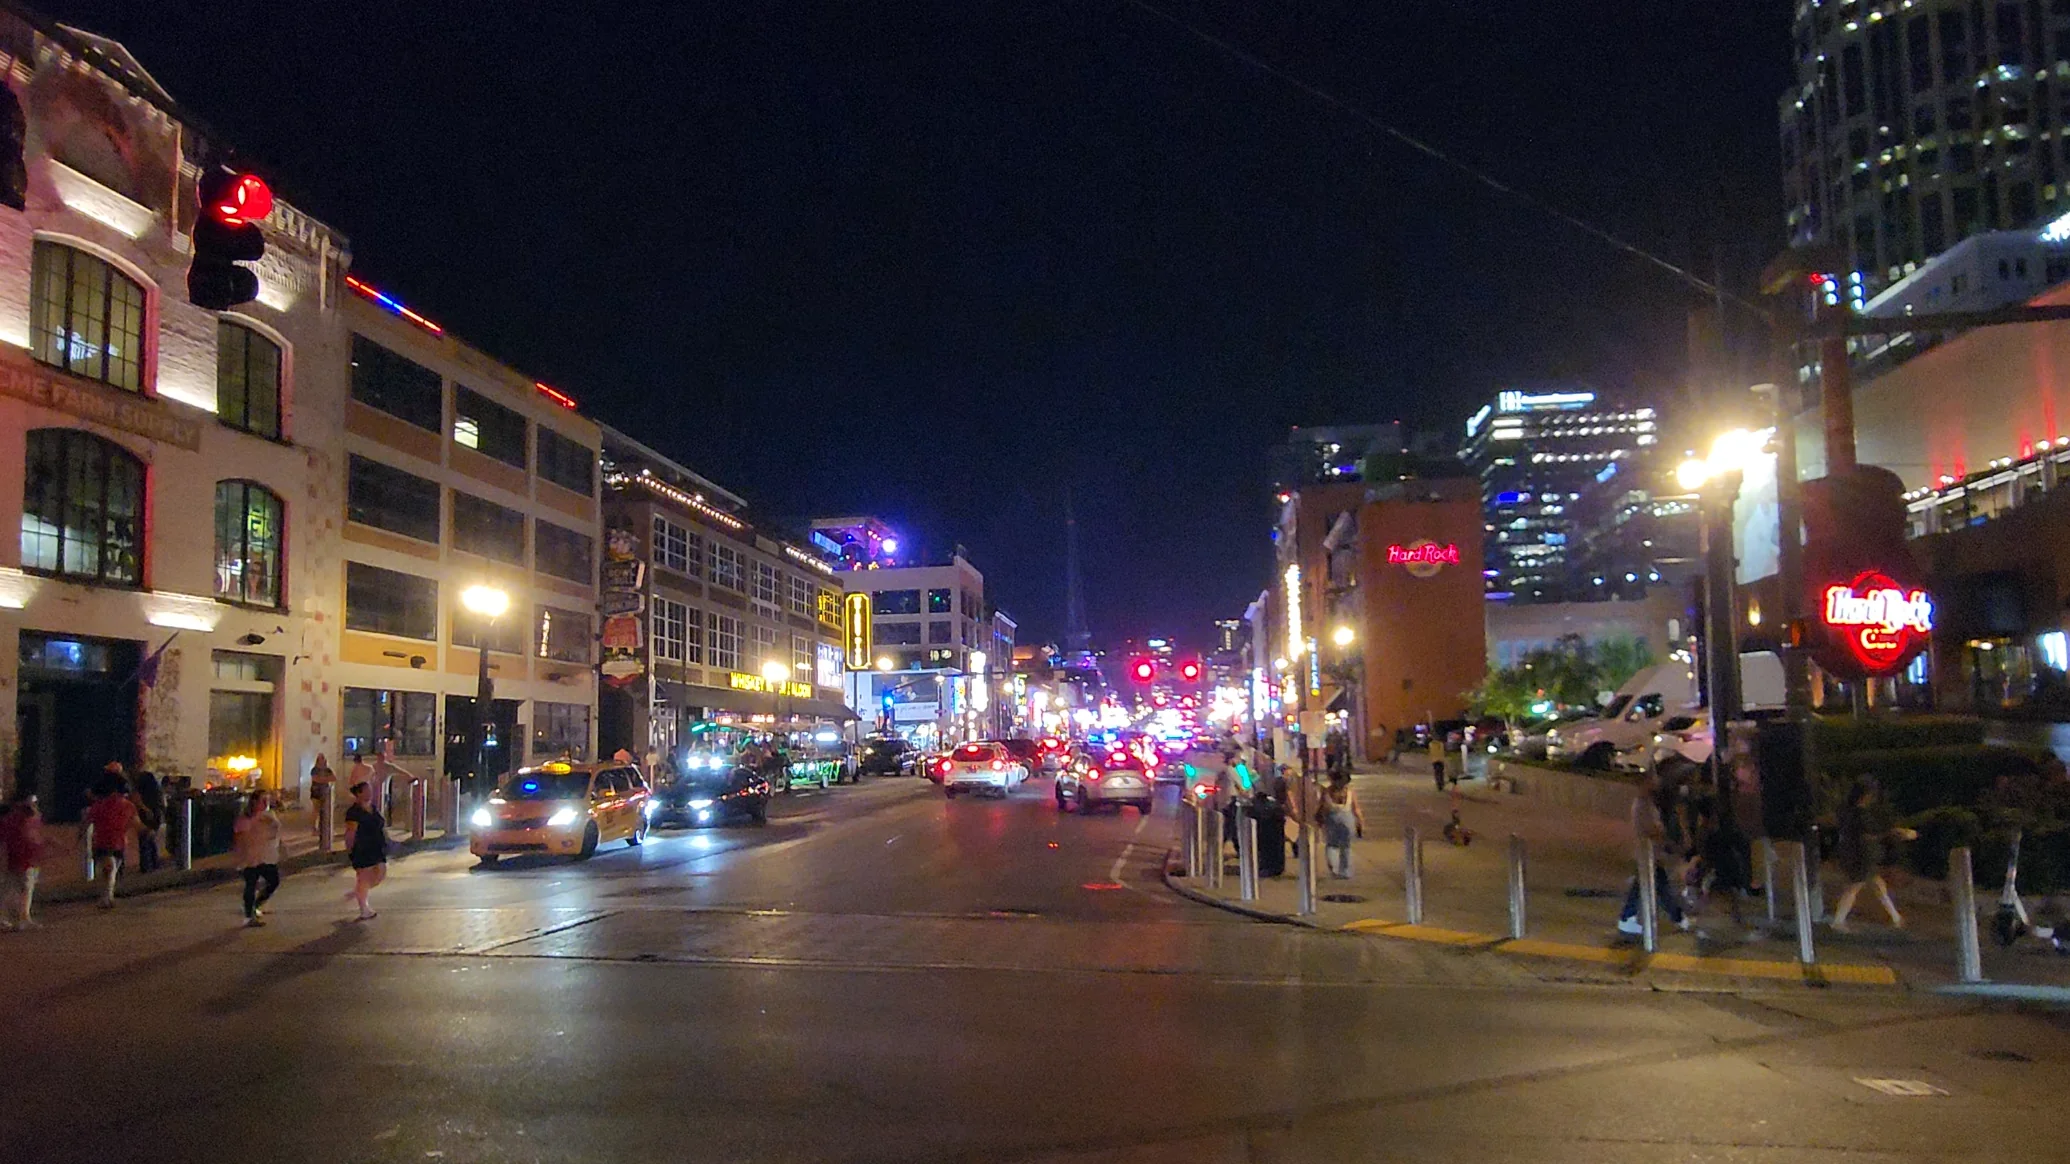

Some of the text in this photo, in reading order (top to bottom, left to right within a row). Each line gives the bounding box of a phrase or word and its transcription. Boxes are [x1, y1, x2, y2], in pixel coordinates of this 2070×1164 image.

[1387, 543, 1459, 565] Hard Rock
[730, 671, 765, 692] WHISKEY
